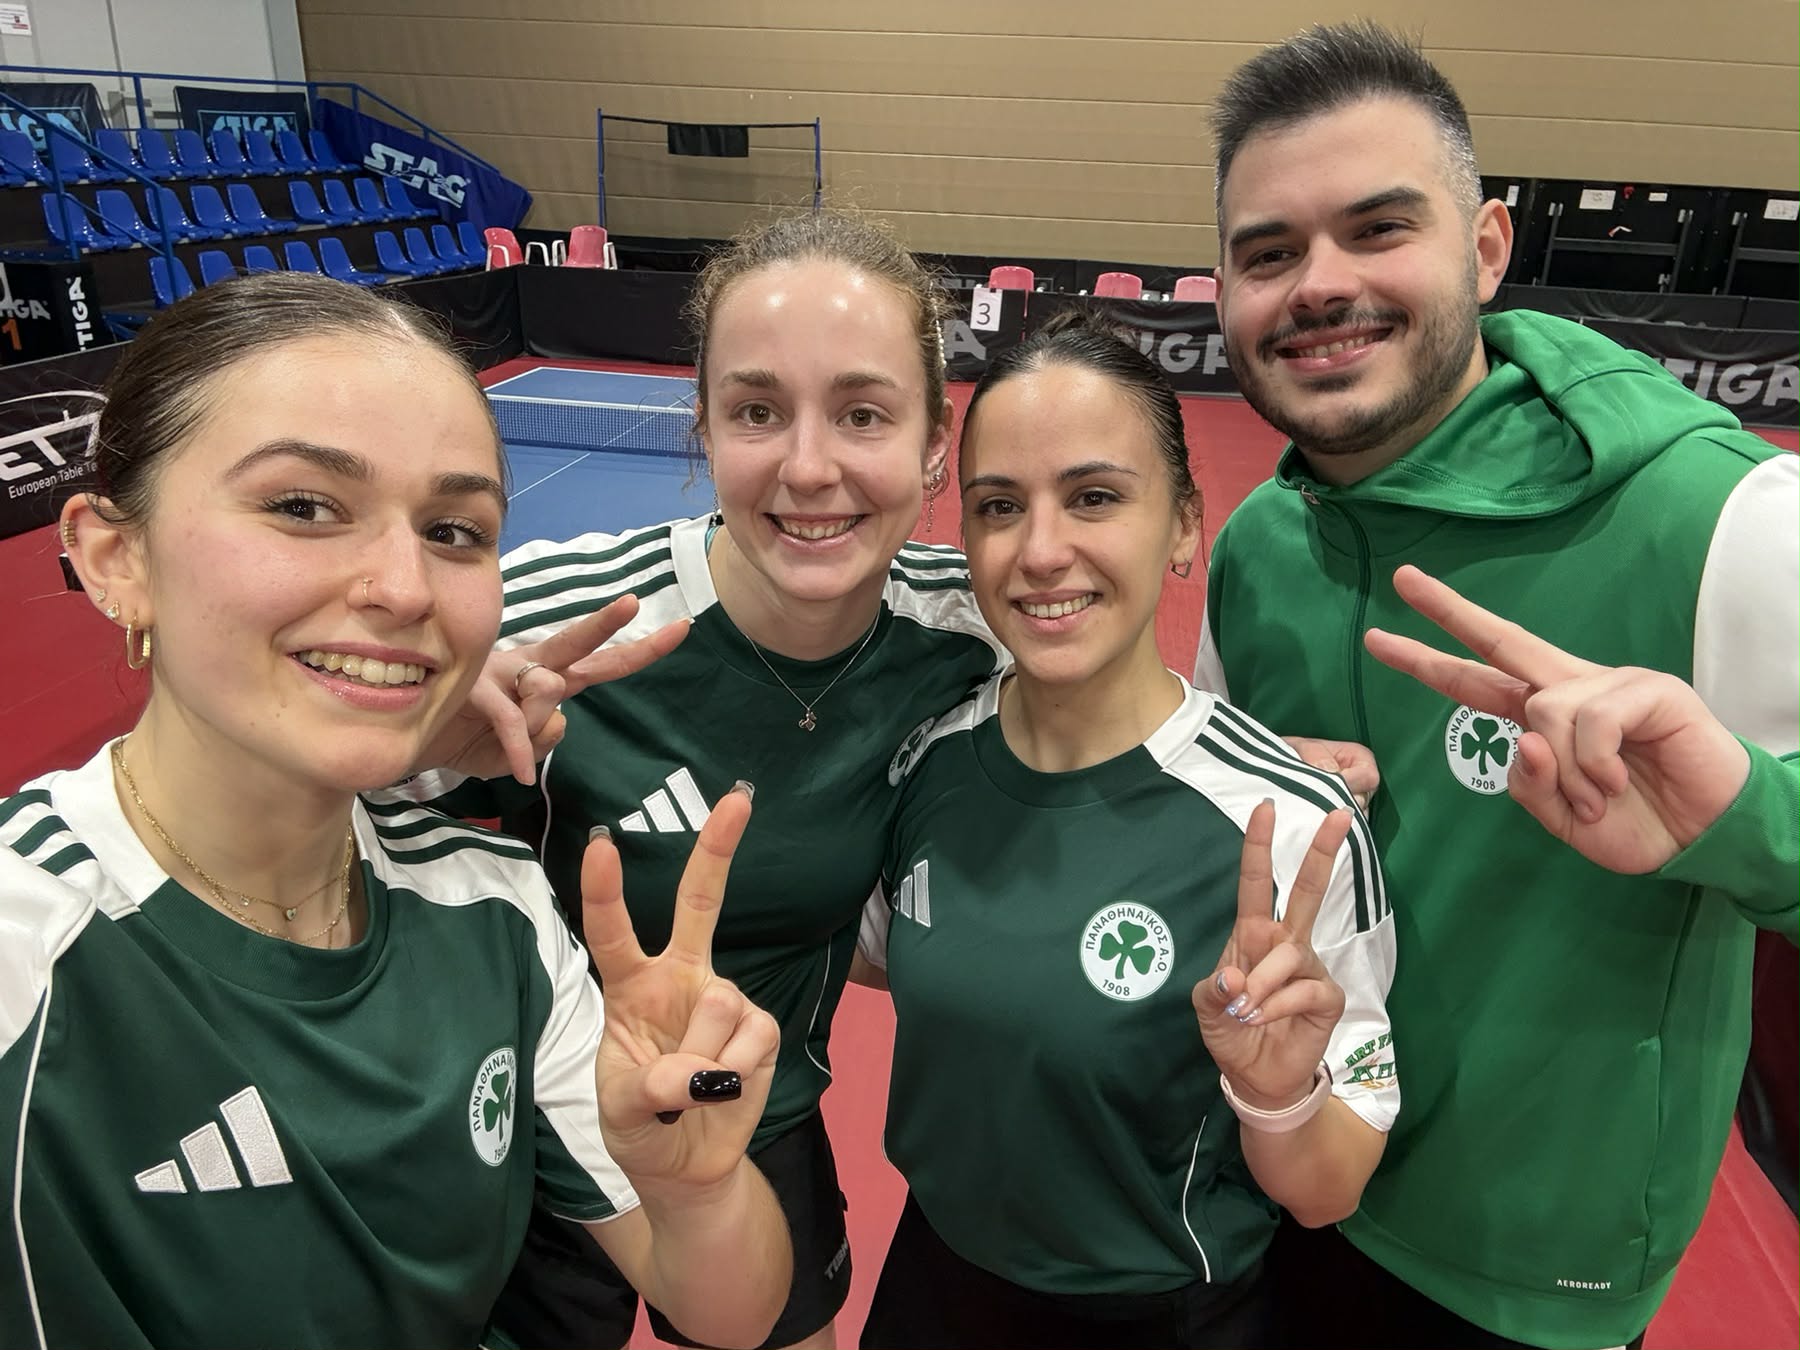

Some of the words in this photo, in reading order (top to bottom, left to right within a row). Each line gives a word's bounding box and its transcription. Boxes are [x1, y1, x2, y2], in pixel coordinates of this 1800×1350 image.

[363, 142, 469, 206] STAG
[69, 276, 94, 351] TIGA
[976, 303, 990, 325] 3
[2, 319, 22, 350] 1
[1654, 357, 1800, 406] TIGA
[8, 475, 57, 499] European
[57, 465, 84, 482] Table
[1471, 777, 1496, 790] 1908
[1102, 979, 1130, 997] 1908
[1345, 1039, 1376, 1070] ART
[1556, 1279, 1611, 1290] AEROREADY
